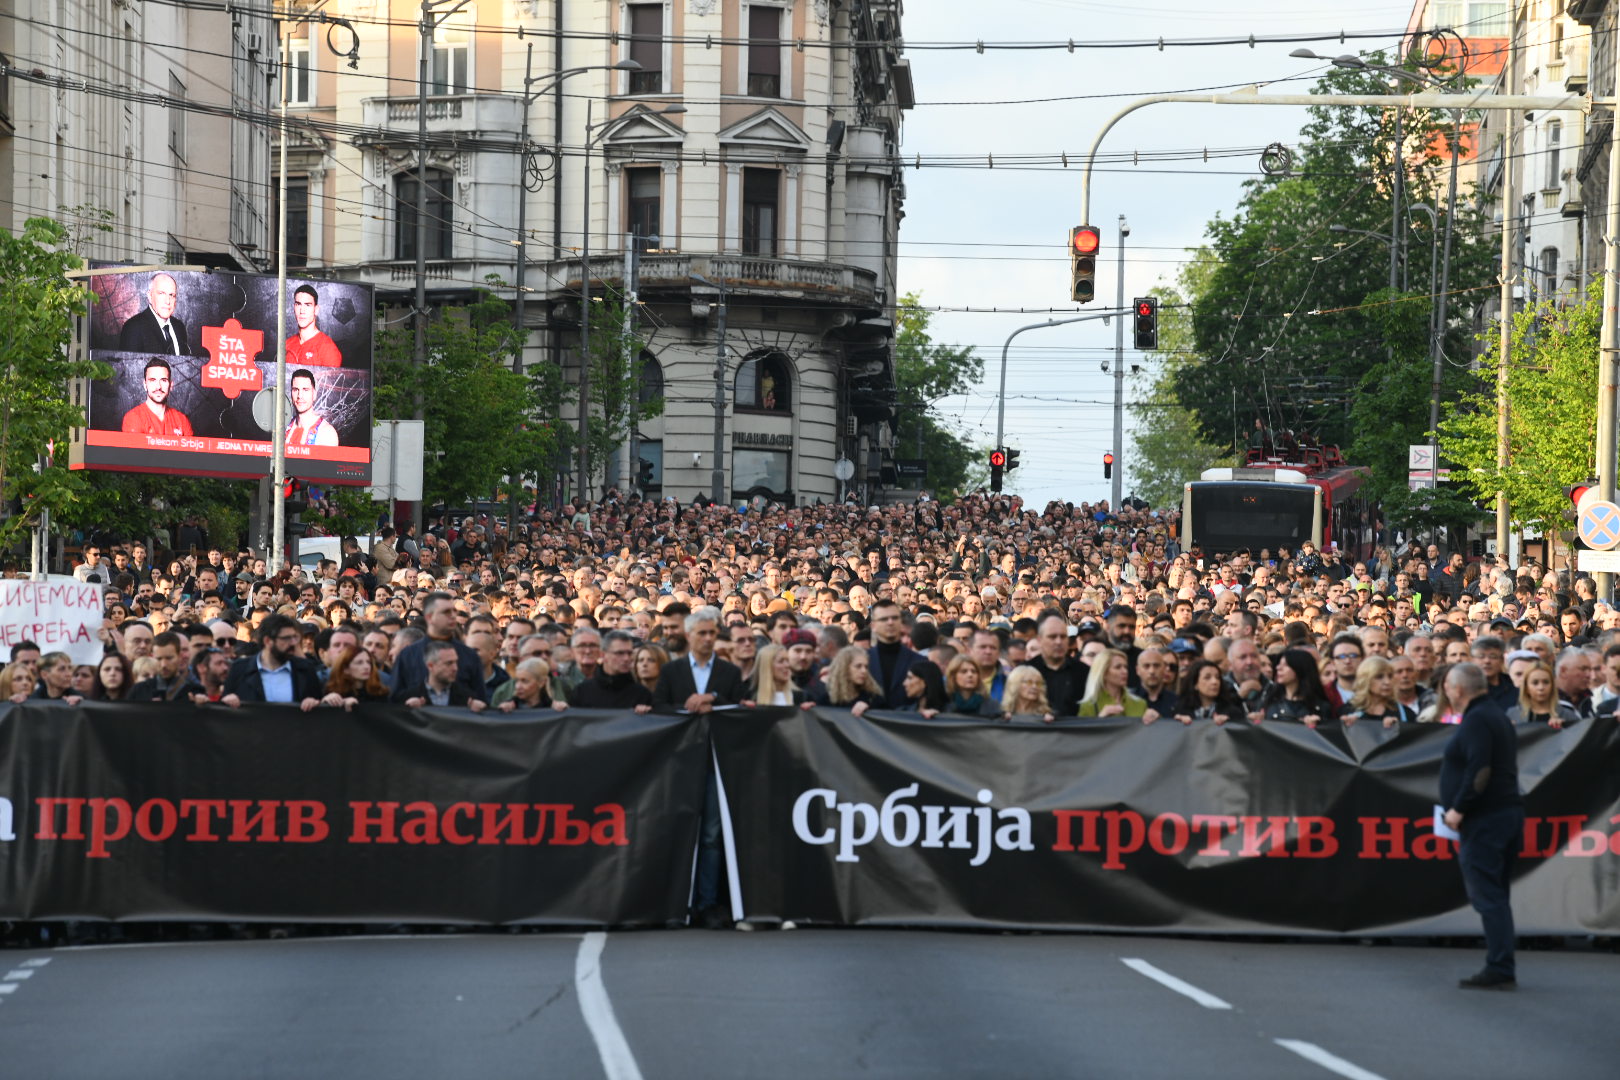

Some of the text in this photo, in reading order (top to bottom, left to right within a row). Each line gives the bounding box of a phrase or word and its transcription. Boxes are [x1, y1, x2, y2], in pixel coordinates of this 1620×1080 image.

[219, 335, 245, 351] ŠTA
[219, 352, 247, 365] NAS
[208, 366, 257, 380] SPAJA?
[146, 436, 204, 450] Telekom Srbija
[216, 442, 241, 451] JEDNA
[34, 796, 330, 858] против
[348, 801, 629, 845] насиља
[792, 782, 1035, 866] Србија
[1052, 808, 1340, 870] против
